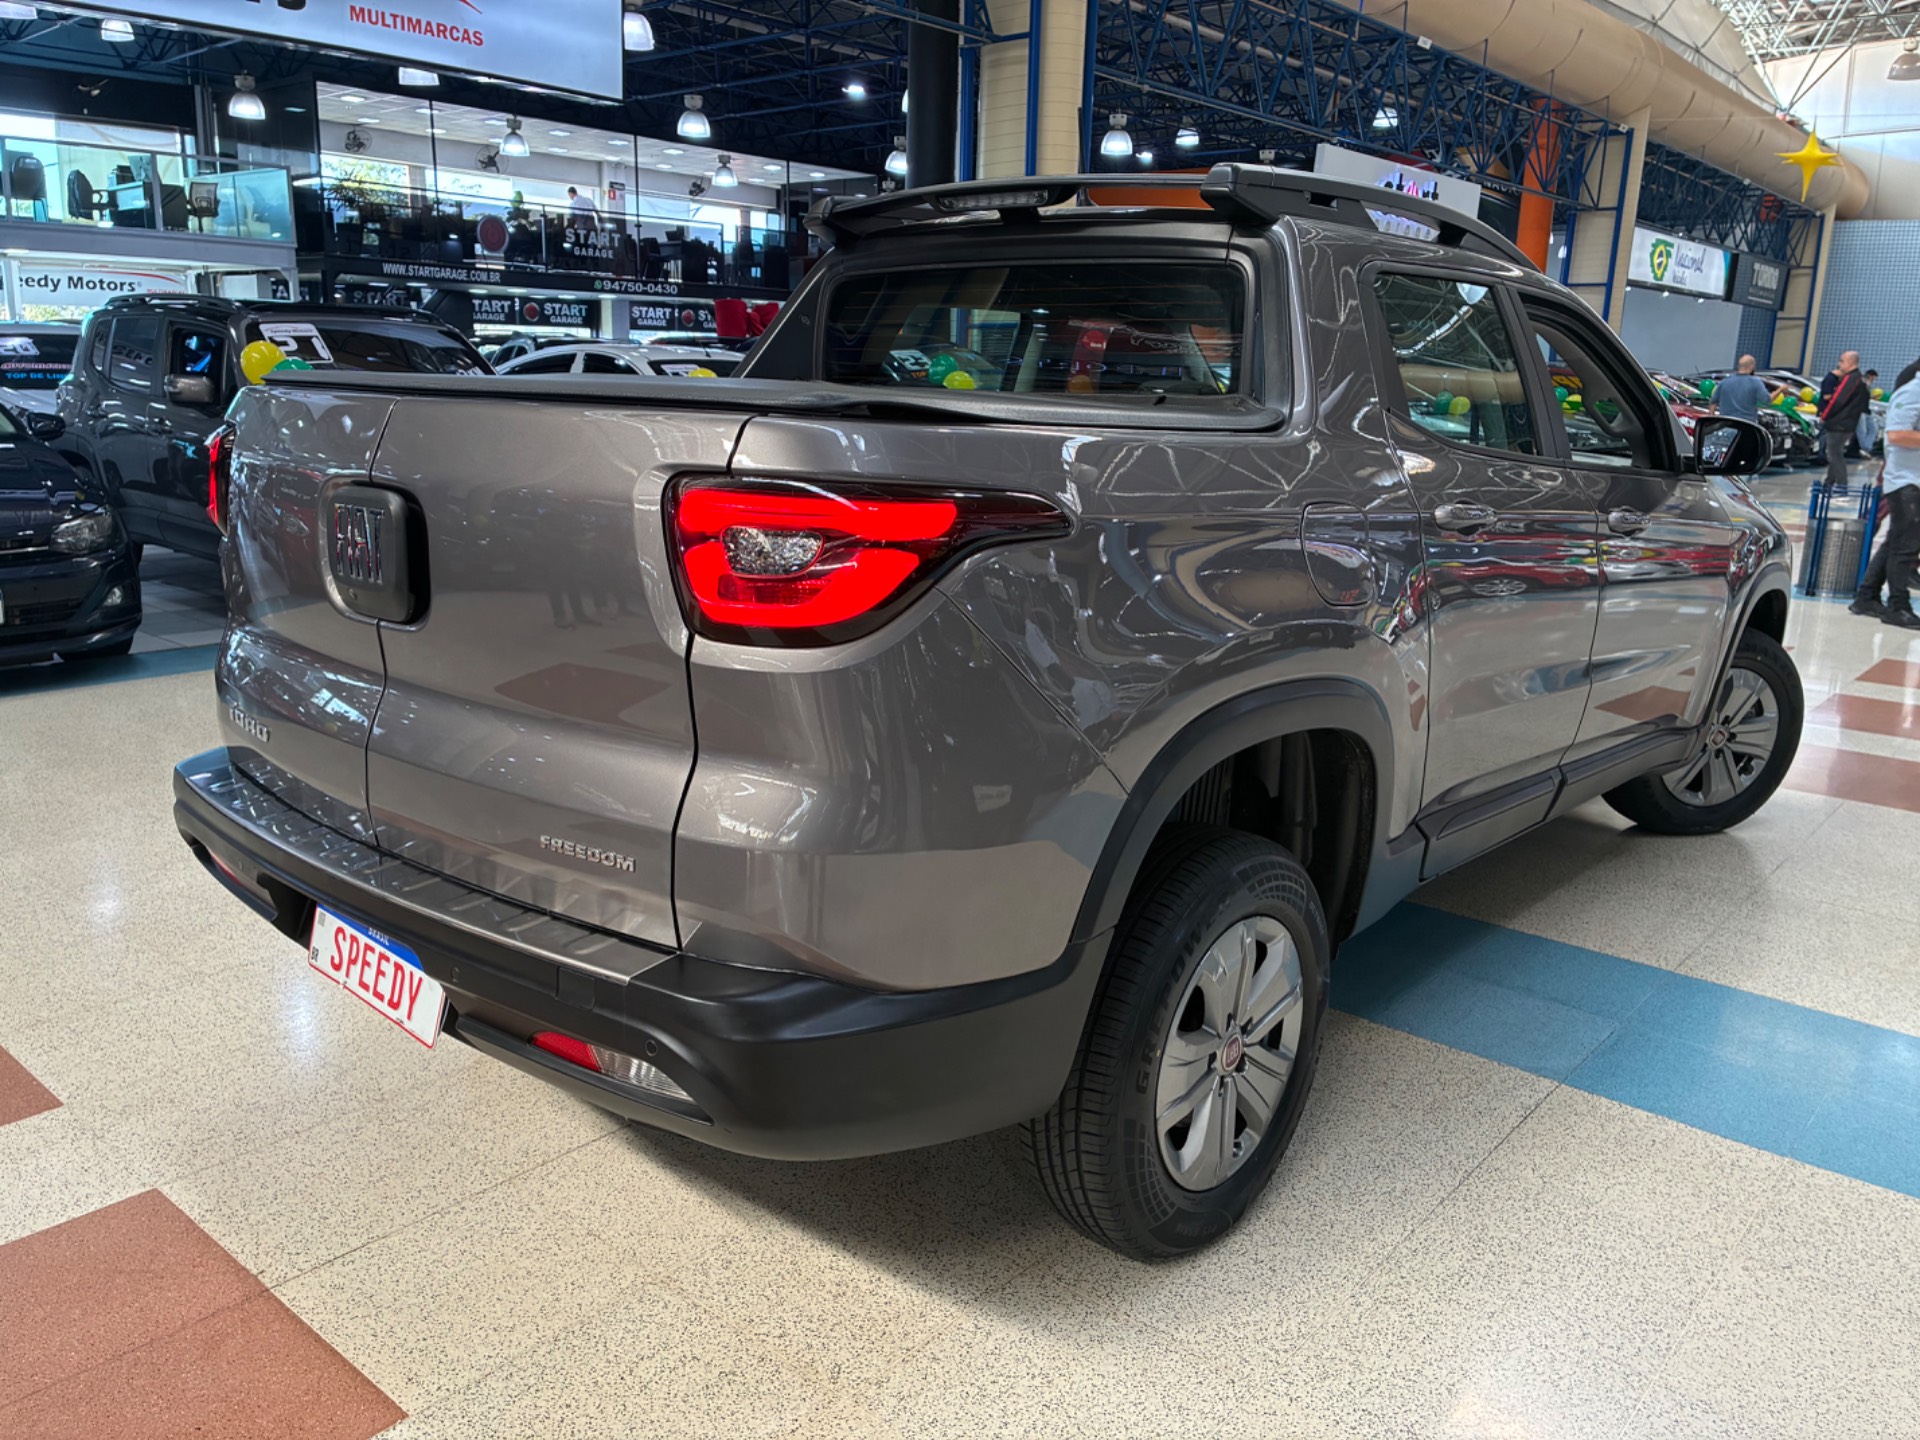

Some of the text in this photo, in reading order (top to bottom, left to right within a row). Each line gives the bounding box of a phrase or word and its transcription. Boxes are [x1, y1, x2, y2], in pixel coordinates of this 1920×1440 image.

[349, 4, 485, 47] MULTIMARCAS
[565, 227, 621, 248] START
[573, 246, 614, 259] GARAGE
[382, 262, 501, 284] WWW.STARTGARAGE.COM.BR
[19, 274, 136, 292] eedy Motors
[603, 279, 678, 295] 94750-0430
[472, 299, 511, 313] TART
[543, 302, 588, 317] START
[631, 306, 672, 319] START
[550, 315, 583, 325] GARAGE
[636, 317, 668, 327] GARAGE
[335, 503, 384, 584] FIAT
[540, 834, 636, 872] FREEDOM
[330, 925, 423, 1021] SPEEDY
